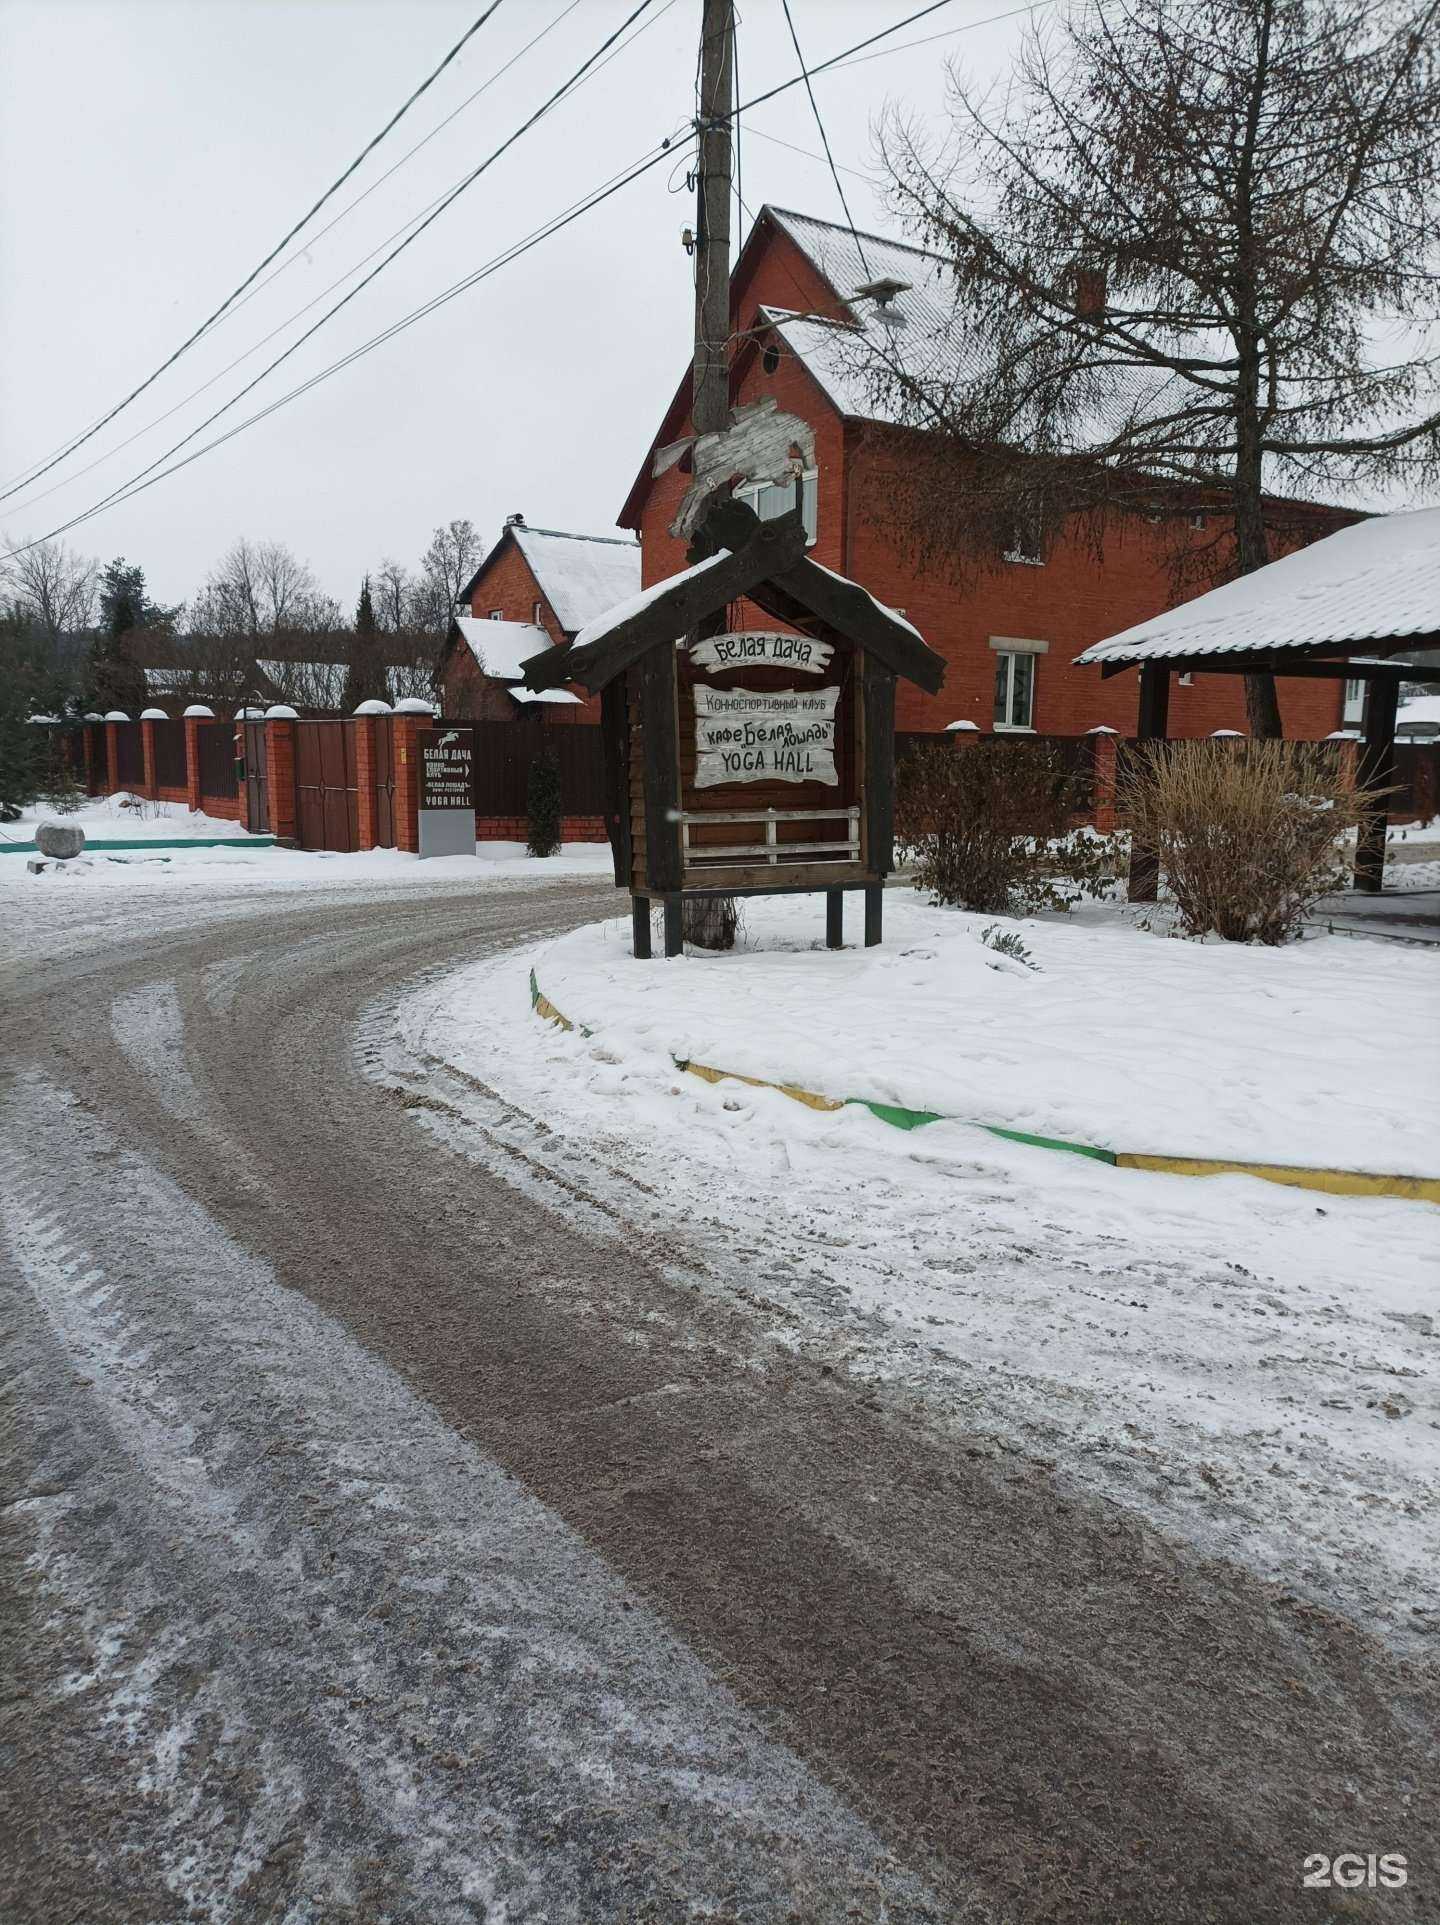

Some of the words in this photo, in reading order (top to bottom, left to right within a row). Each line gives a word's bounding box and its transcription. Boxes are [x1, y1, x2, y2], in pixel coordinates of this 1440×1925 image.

[714, 637, 766, 661] Белая
[424, 749, 448, 760] БЕЛАЯ
[451, 749, 471, 760] ДАЧА
[721, 752, 765, 772] YOGA
[774, 751, 813, 772] HALL
[426, 796, 448, 806] YOGA
[451, 796, 471, 806] HALL
